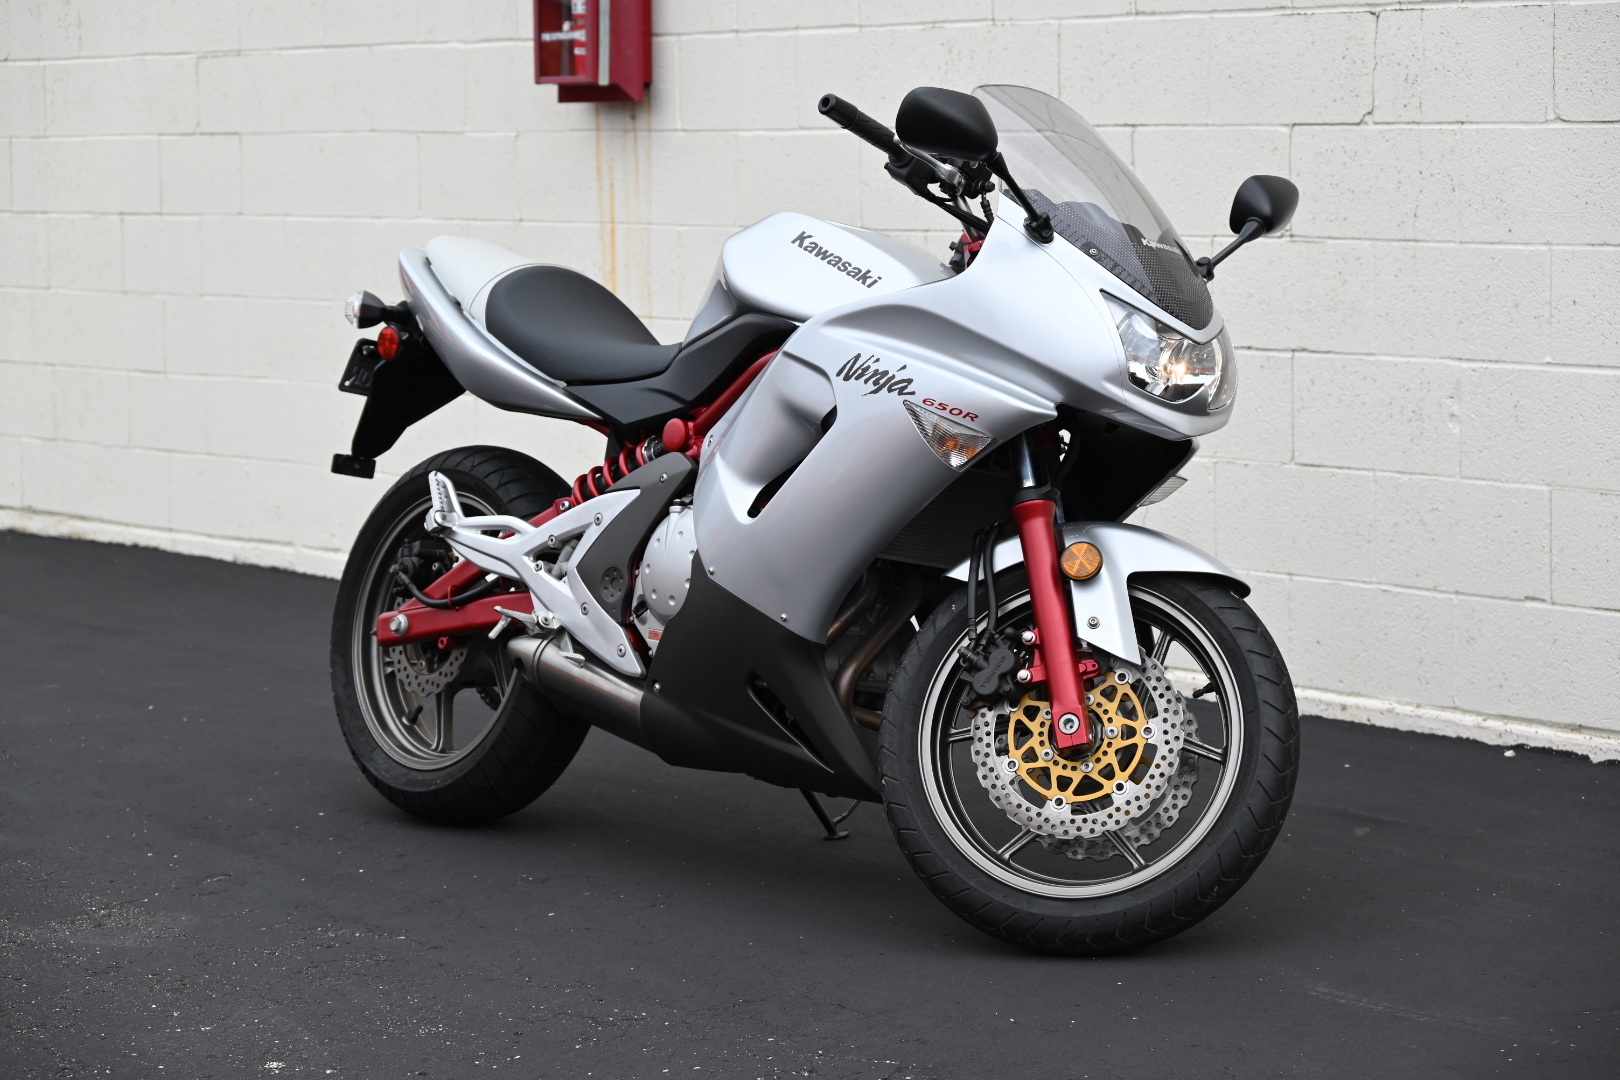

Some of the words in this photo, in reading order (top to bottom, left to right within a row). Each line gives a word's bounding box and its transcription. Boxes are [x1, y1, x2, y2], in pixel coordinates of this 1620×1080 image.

[790, 230, 883, 289] Kawasaki
[835, 352, 916, 397] Ninja
[922, 397, 979, 422] 650R
